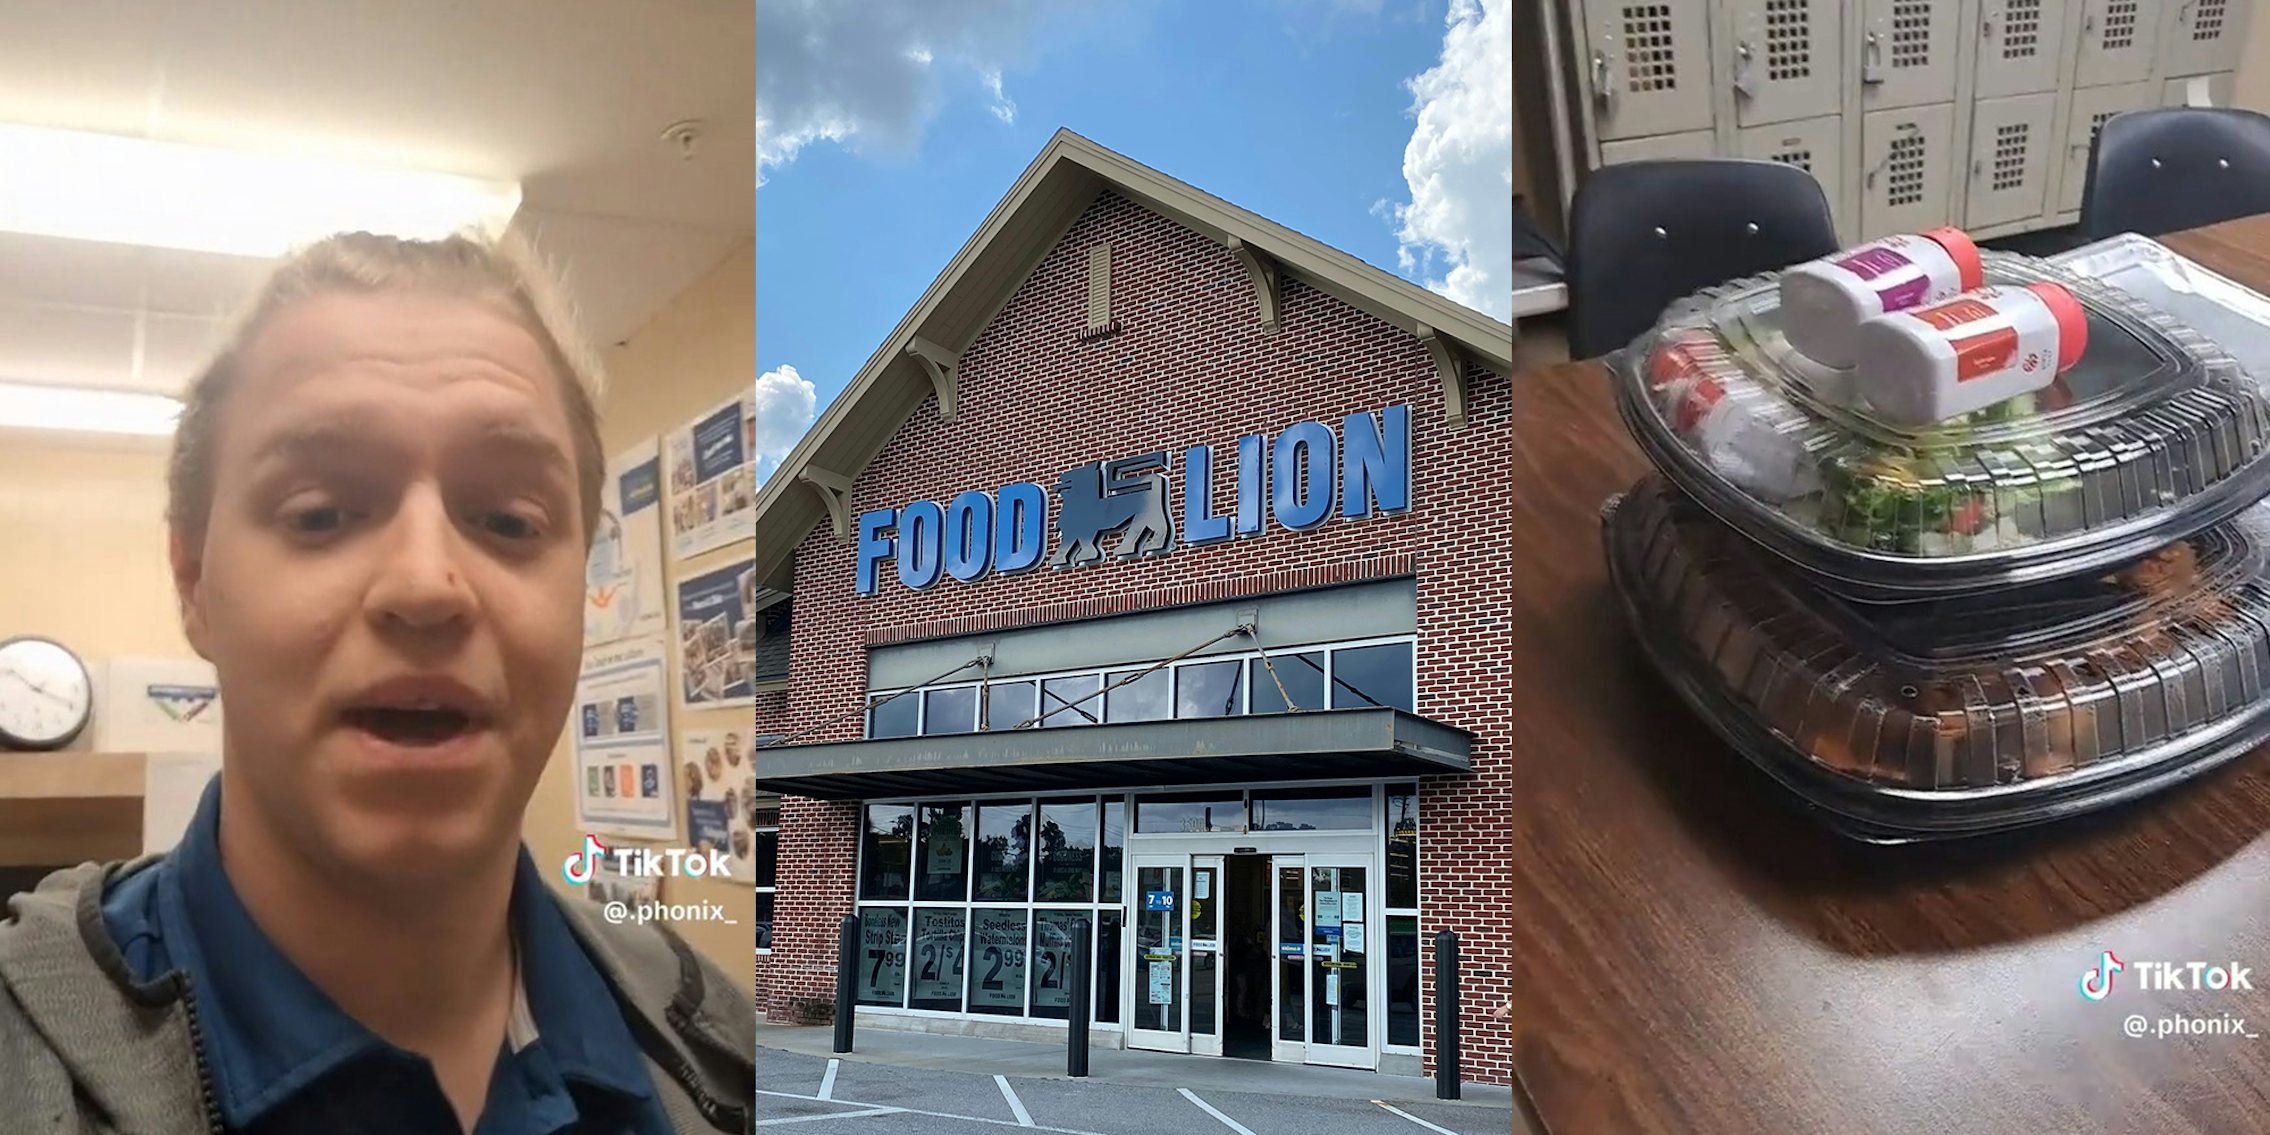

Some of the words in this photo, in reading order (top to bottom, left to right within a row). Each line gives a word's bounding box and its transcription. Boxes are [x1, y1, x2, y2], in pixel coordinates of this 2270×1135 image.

[855, 482, 1048, 597] FOOD
[1184, 404, 1414, 547] LION
[1148, 895, 1155, 904] 7
[1162, 896, 1174, 906] 10
[925, 916, 965, 928] Tostitos
[983, 919, 1027, 931] Seedless
[865, 930, 884, 947] Strip
[885, 930, 907, 944] Stea
